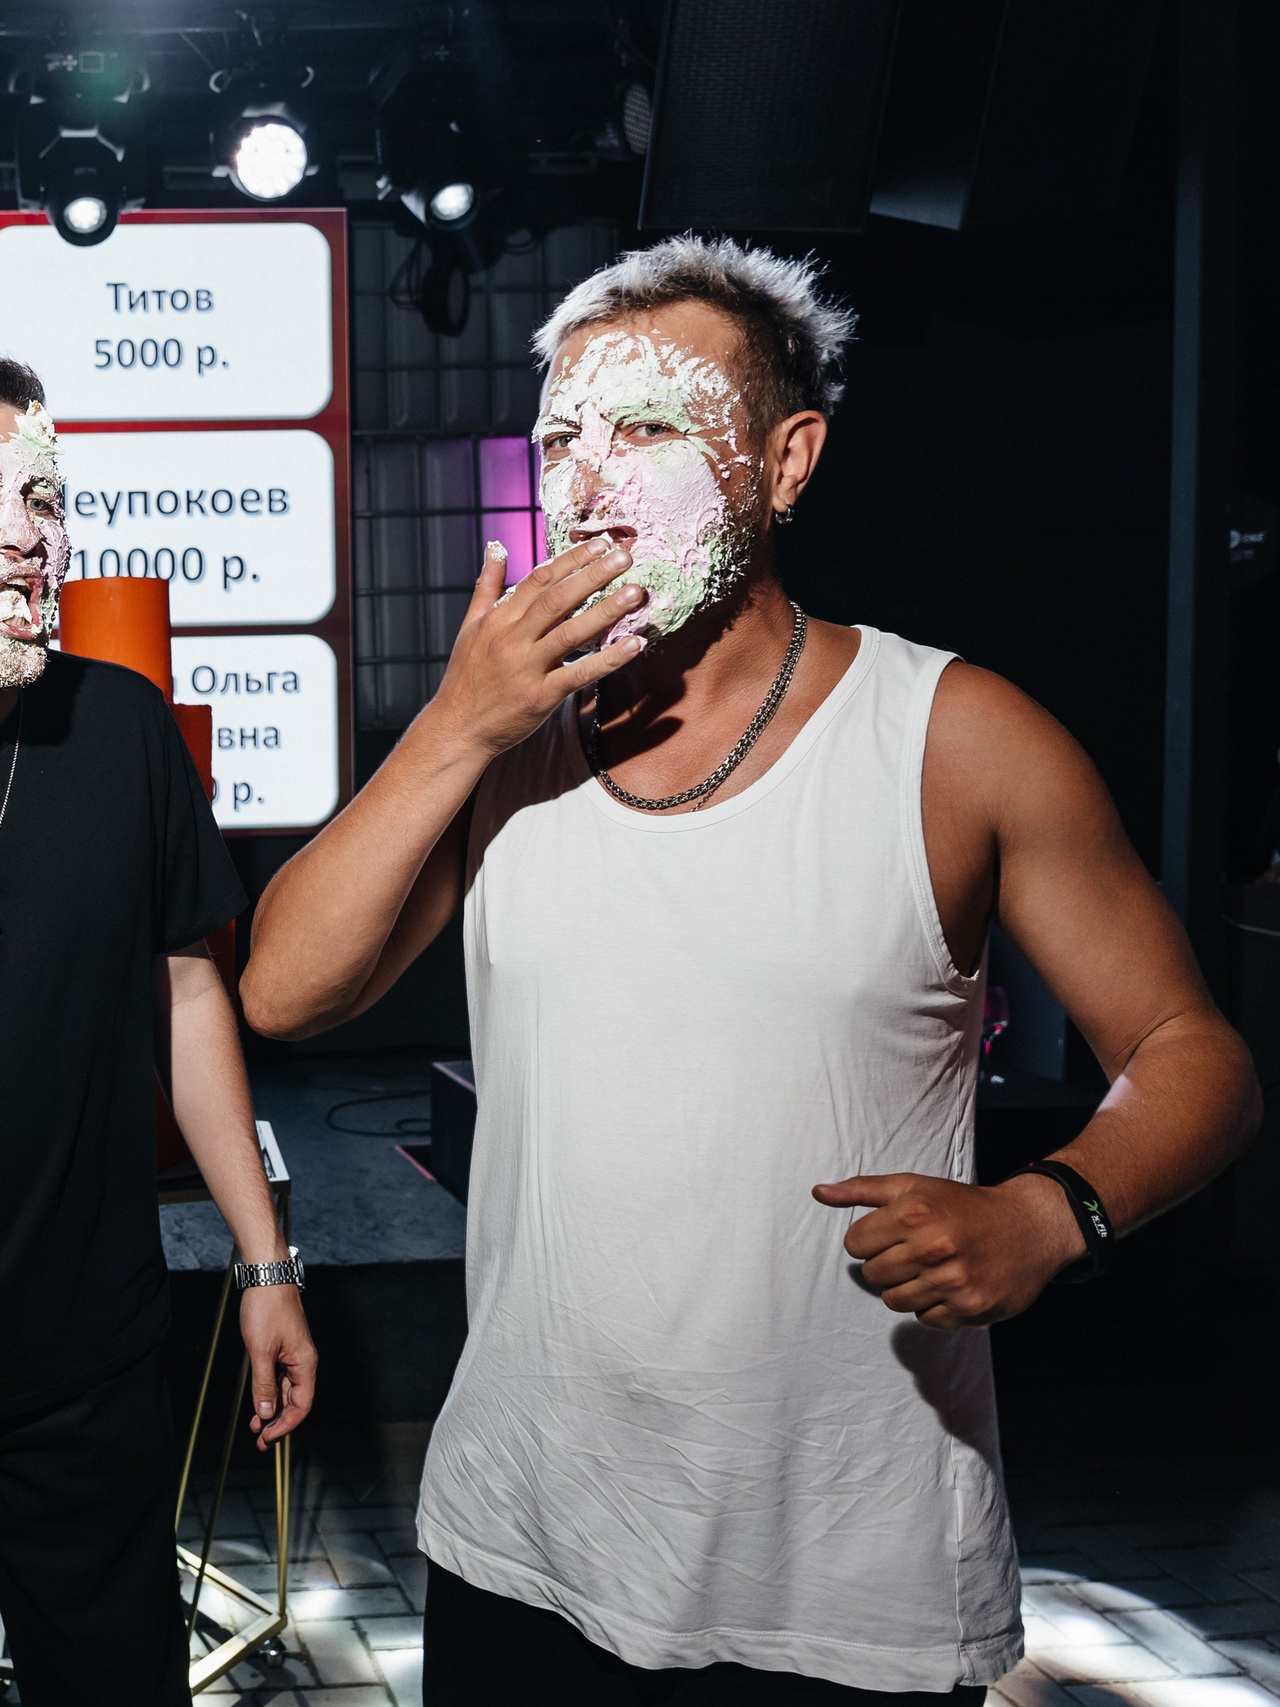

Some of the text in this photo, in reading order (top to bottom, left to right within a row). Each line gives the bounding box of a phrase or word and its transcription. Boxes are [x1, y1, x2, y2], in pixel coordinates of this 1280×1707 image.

[105, 282, 214, 312] Титов
[94, 338, 183, 369] 5000
[61, 484, 290, 526] еупокоев
[73, 547, 205, 582] 10000
[191, 664, 300, 695] Ольга
